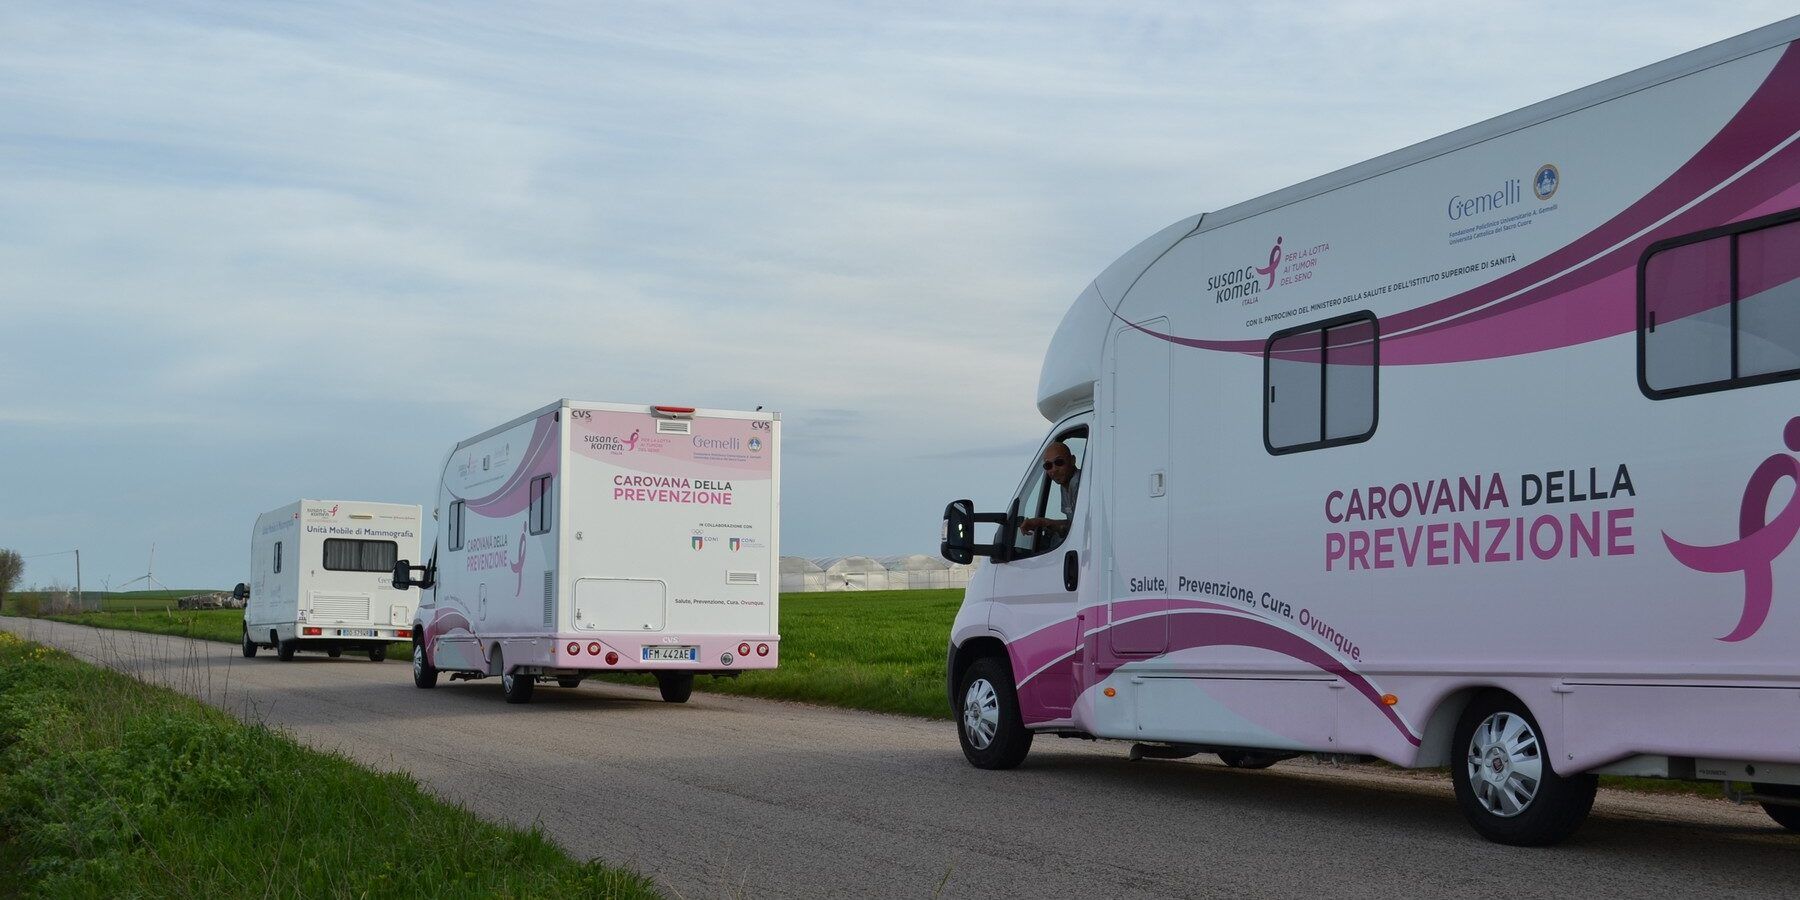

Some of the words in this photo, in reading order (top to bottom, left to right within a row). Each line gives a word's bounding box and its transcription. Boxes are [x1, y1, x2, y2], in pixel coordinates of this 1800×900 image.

[1448, 179, 1520, 220] Gemelli
[1285, 252, 1297, 262] PER
[1298, 249, 1308, 259] LA
[1309, 243, 1330, 256] LOTTA
[1283, 266, 1290, 274] AI
[1292, 258, 1318, 272] TUMORI
[1280, 277, 1293, 287] DEL
[1294, 271, 1313, 283] SENO
[1246, 319, 1258, 327] CON
[1264, 309, 1298, 323] PATROCINIO
[1298, 306, 1310, 315] DEL
[1310, 298, 1342, 313] MINISTERO
[1343, 292, 1363, 304] DELLA
[1363, 286, 1387, 299] SALUTE
[1387, 285, 1392, 293] E
[1393, 273, 1440, 291] DELL'ISTITUTO
[1441, 263, 1480, 280] SUPERIORE
[1481, 261, 1489, 270] DI
[1490, 253, 1517, 268] SANITÀ
[1242, 296, 1259, 306] ITALIA
[572, 410, 591, 418] CVS
[752, 421, 770, 429] CVS
[692, 435, 740, 450] Gemelli
[614, 475, 690, 488] CAROVANA
[694, 480, 732, 490] DELLA
[614, 488, 732, 505] PREVENZIONE
[1325, 472, 1509, 524] CAROVANA
[1521, 463, 1636, 507] DELLA
[306, 525, 327, 533] Unità
[329, 527, 354, 535] Mobile
[364, 529, 414, 538] Mammografia
[1326, 507, 1635, 572] PREVENZIONE
[467, 536, 493, 553] CAROVANA
[494, 534, 508, 548] DELLA
[467, 550, 508, 573] PREVENZIONE
[1130, 576, 1168, 594] Salute,
[1178, 576, 1256, 608] Prevenzione,
[1260, 592, 1294, 620] Cura.
[1299, 608, 1363, 663] Ovunque.
[649, 649, 660, 659] FM
[662, 649, 690, 659] 442AE
